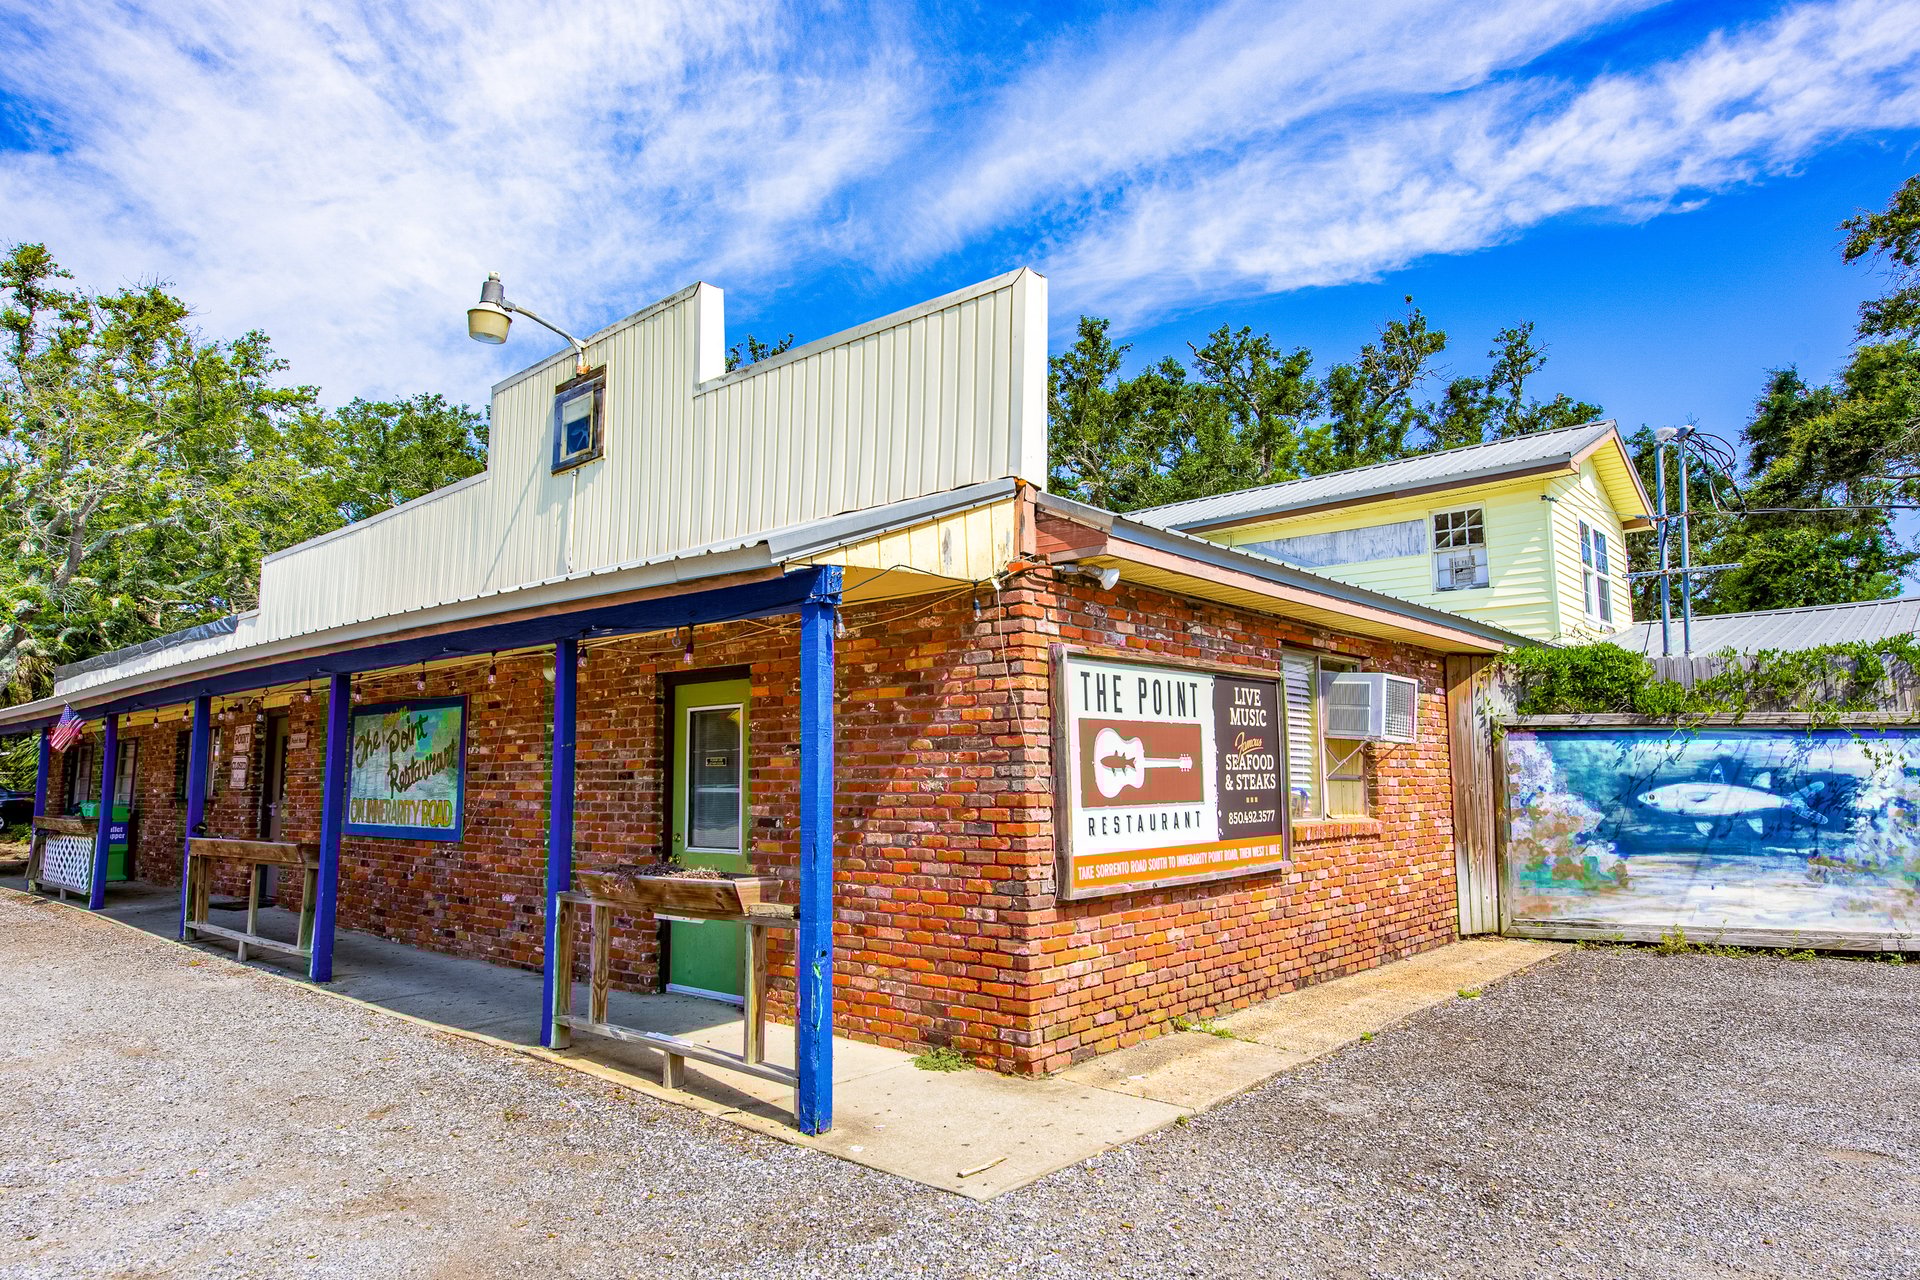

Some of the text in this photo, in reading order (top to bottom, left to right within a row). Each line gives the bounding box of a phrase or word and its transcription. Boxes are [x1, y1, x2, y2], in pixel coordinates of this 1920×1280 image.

[1080, 671, 1198, 717] THE POINT
[1234, 686, 1261, 706] LIVE
[1229, 707, 1267, 727] MUSIC
[355, 713, 428, 768] The Point
[1234, 731, 1264, 758] Famous
[387, 738, 456, 799] Restaurant
[1225, 753, 1275, 771] SEAFOOD
[1225, 773, 1276, 791] & STEAKS
[351, 797, 365, 823] ON
[421, 799, 453, 828] ROAD
[1088, 810, 1201, 837] RESTAURANT
[1228, 809, 1276, 825] 850.492.3577
[1077, 865, 1095, 881] TAKE
[1095, 861, 1130, 879] SORRENTO
[1130, 858, 1147, 874] ROAD
[1148, 856, 1168, 871] SOUTH
[1168, 855, 1176, 869] TO
[1176, 852, 1208, 868] INNERARITY
[1208, 850, 1223, 864] POINT
[1223, 848, 1239, 862] ROAD,
[1239, 847, 1252, 860] THEN
[1252, 845, 1265, 858] WEST
[1269, 843, 1281, 856] MILE
